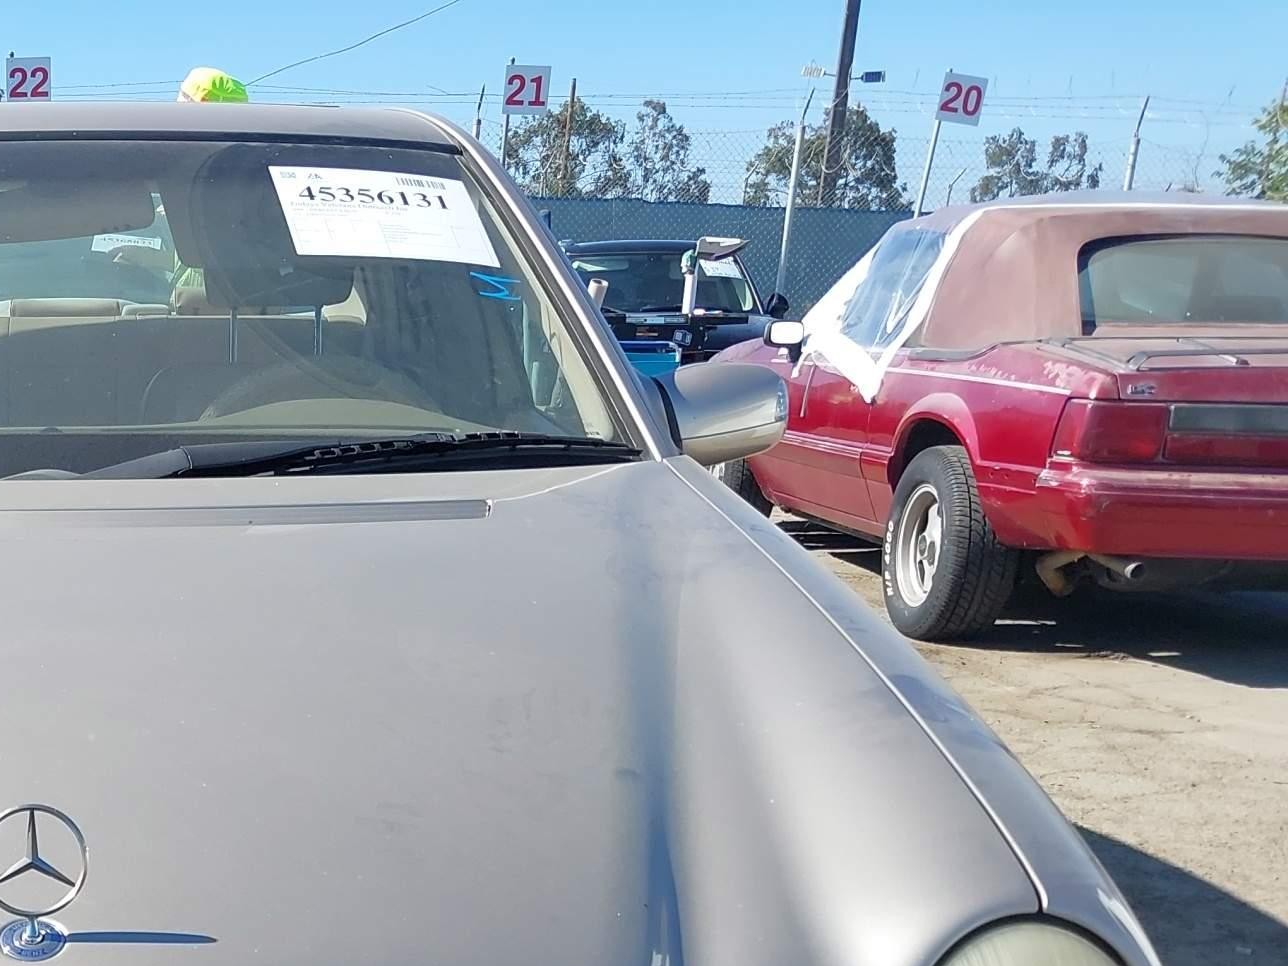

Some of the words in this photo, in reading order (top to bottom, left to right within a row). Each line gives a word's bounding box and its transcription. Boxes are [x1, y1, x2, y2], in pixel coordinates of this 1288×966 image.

[9, 66, 49, 98] 22
[505, 74, 546, 107] 21
[940, 81, 983, 117] 20
[298, 185, 449, 211] 45356131
[884, 520, 894, 565] 4000
